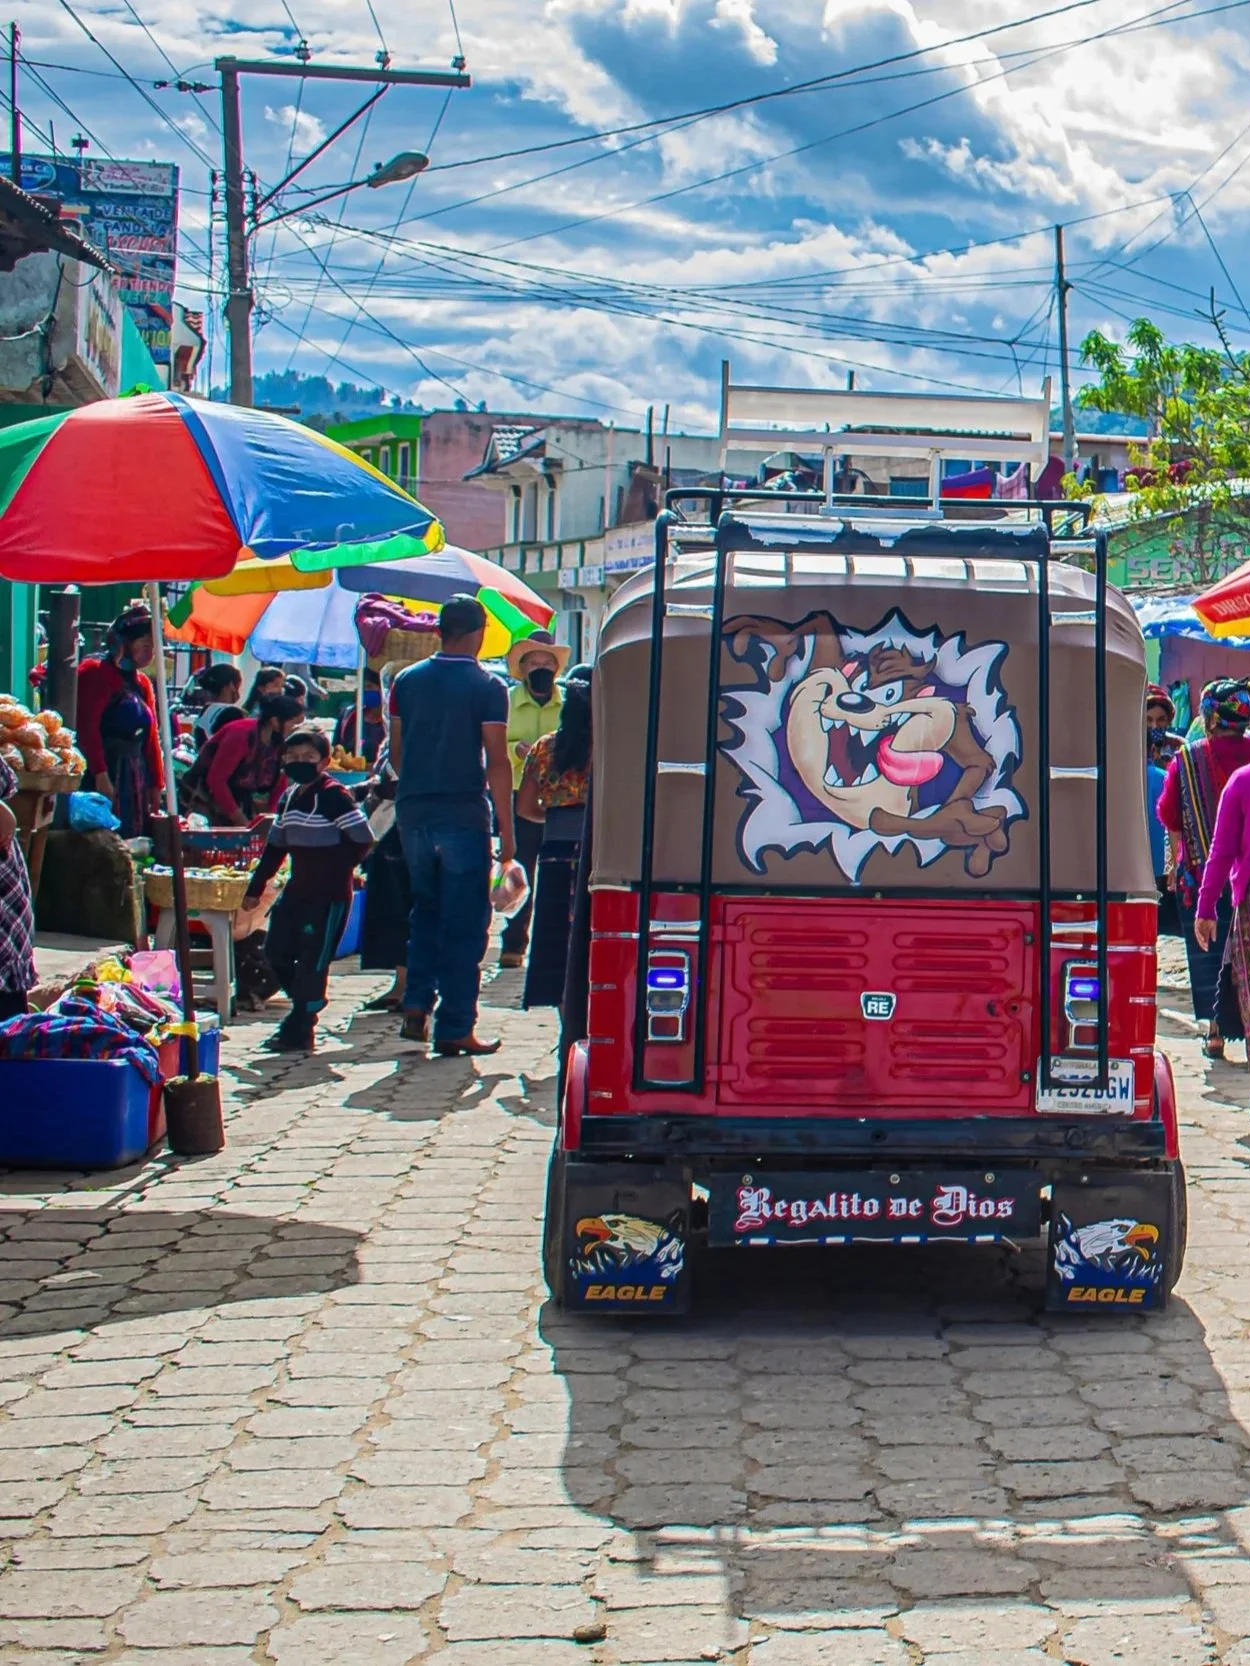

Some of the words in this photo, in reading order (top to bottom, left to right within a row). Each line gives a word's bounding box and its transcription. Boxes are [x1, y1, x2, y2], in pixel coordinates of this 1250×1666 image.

[867, 1000, 889, 1014] RE
[734, 1186, 881, 1230] Regalito
[932, 1185, 1016, 1226] Dios
[584, 1285, 667, 1300] EAGLE
[1067, 1287, 1146, 1303] EAGLE
